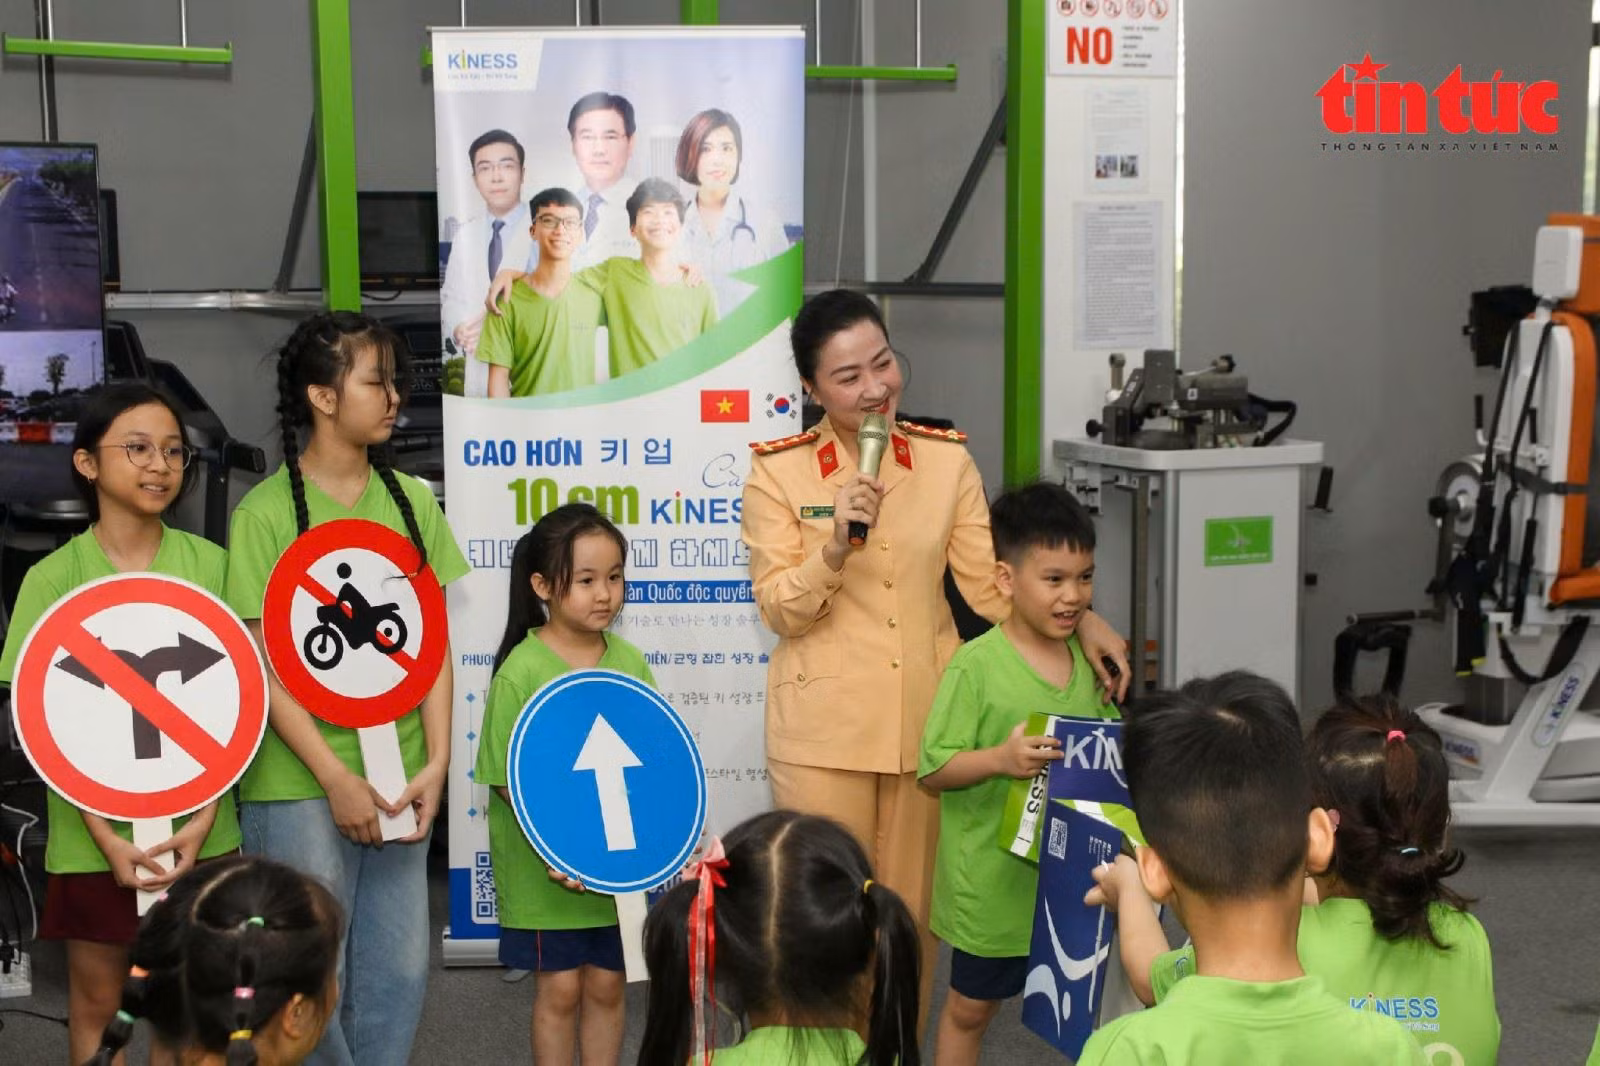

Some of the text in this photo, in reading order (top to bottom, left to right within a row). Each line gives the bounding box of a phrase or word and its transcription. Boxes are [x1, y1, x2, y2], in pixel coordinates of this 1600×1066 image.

[1066, 27, 1113, 65] NO
[463, 439, 517, 467] CAO
[525, 437, 582, 467] HƠN
[507, 477, 559, 525] 10
[624, 583, 643, 601] àn
[648, 582, 682, 603] Quốc
[686, 582, 711, 603] độc
